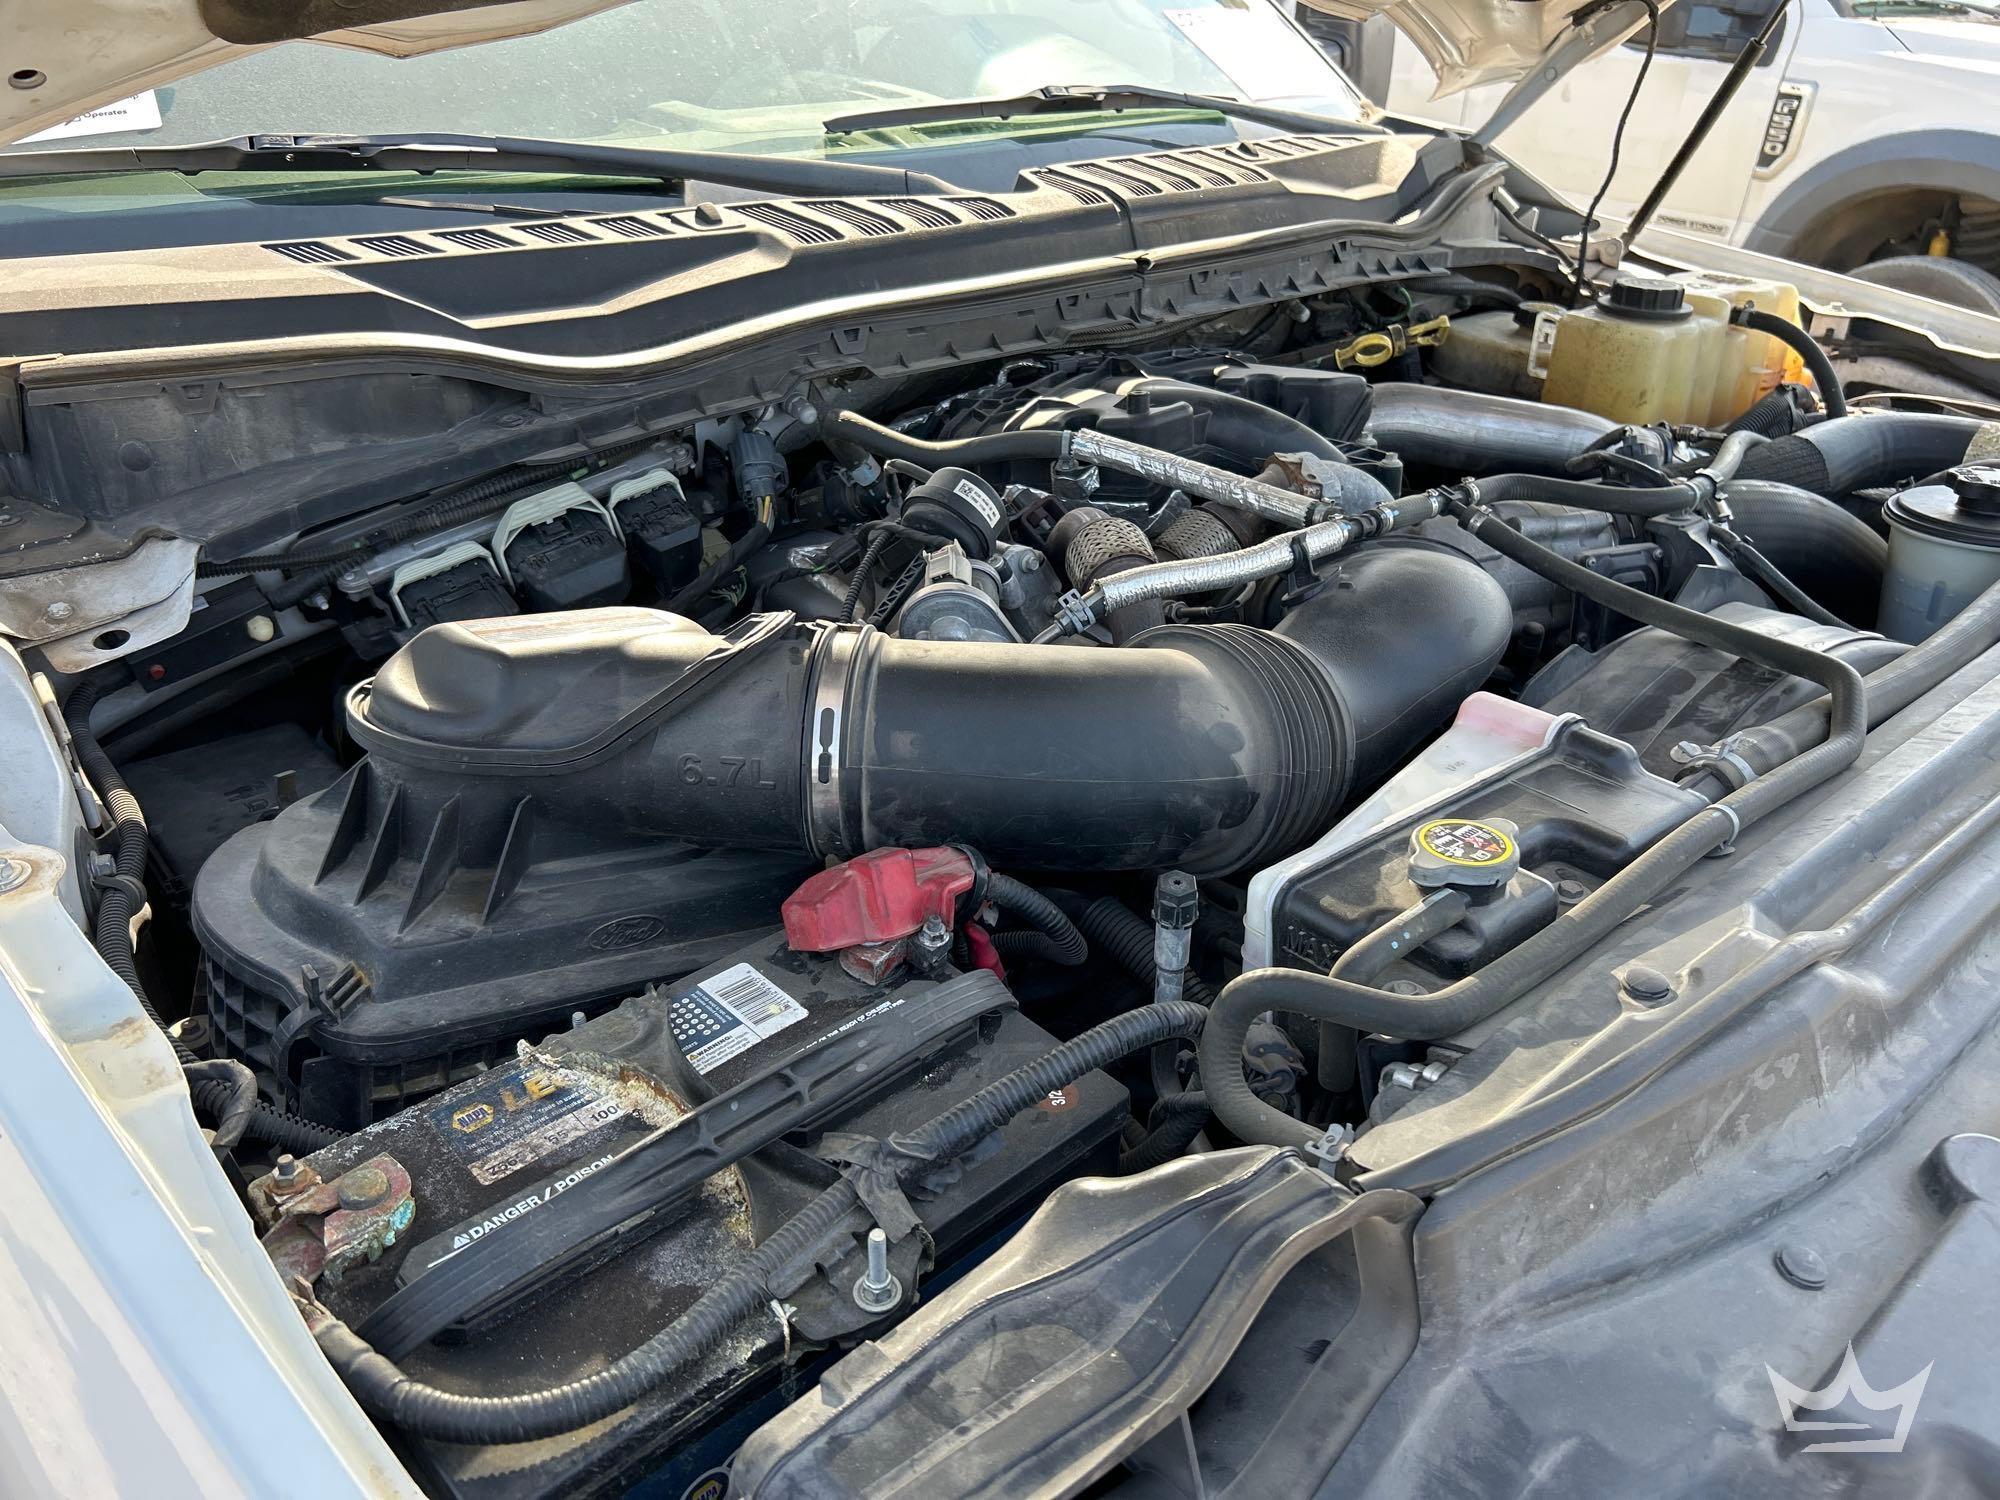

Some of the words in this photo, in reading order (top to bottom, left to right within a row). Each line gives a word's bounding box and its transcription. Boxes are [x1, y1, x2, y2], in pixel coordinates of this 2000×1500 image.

[83, 109, 128, 119] Operates
[678, 752, 777, 790] 6.7L
[599, 916, 657, 947] Ford
[457, 1105, 490, 1129] NAPA
[468, 1195, 543, 1239] DANGER
[554, 1154, 616, 1193] POISON
[697, 1485, 719, 1500] APA
